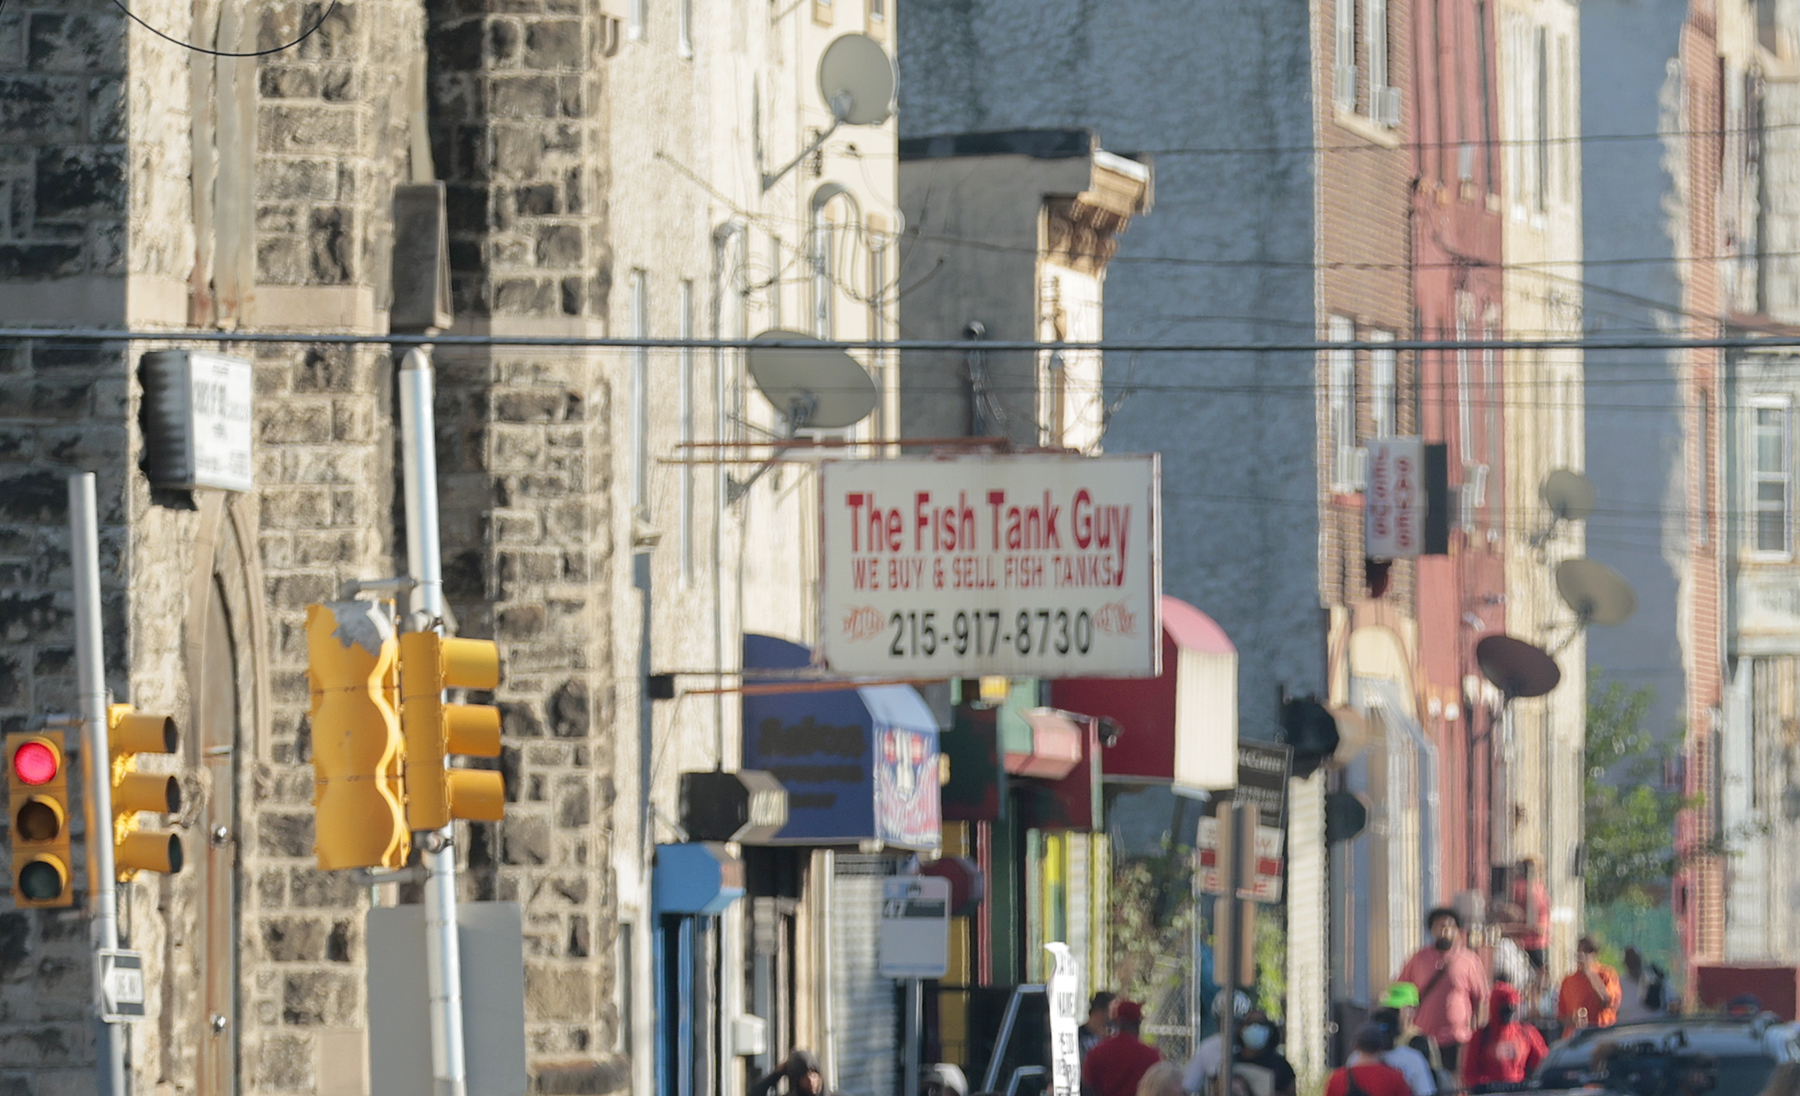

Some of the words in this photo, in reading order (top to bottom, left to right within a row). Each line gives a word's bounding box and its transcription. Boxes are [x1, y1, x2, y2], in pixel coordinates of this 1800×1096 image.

[846, 491, 902, 553] The
[914, 489, 976, 552] Fish
[986, 488, 1061, 551] Tank
[1071, 487, 1132, 587] Guy
[852, 557, 880, 591] WE
[887, 556, 925, 591] BUY
[932, 557, 945, 590] &
[952, 556, 997, 589] SELL
[1003, 556, 1044, 589] FISH
[1051, 555, 1115, 588] TANKS
[888, 607, 1093, 660] 215-917-8730
[883, 900, 907, 918] 47
